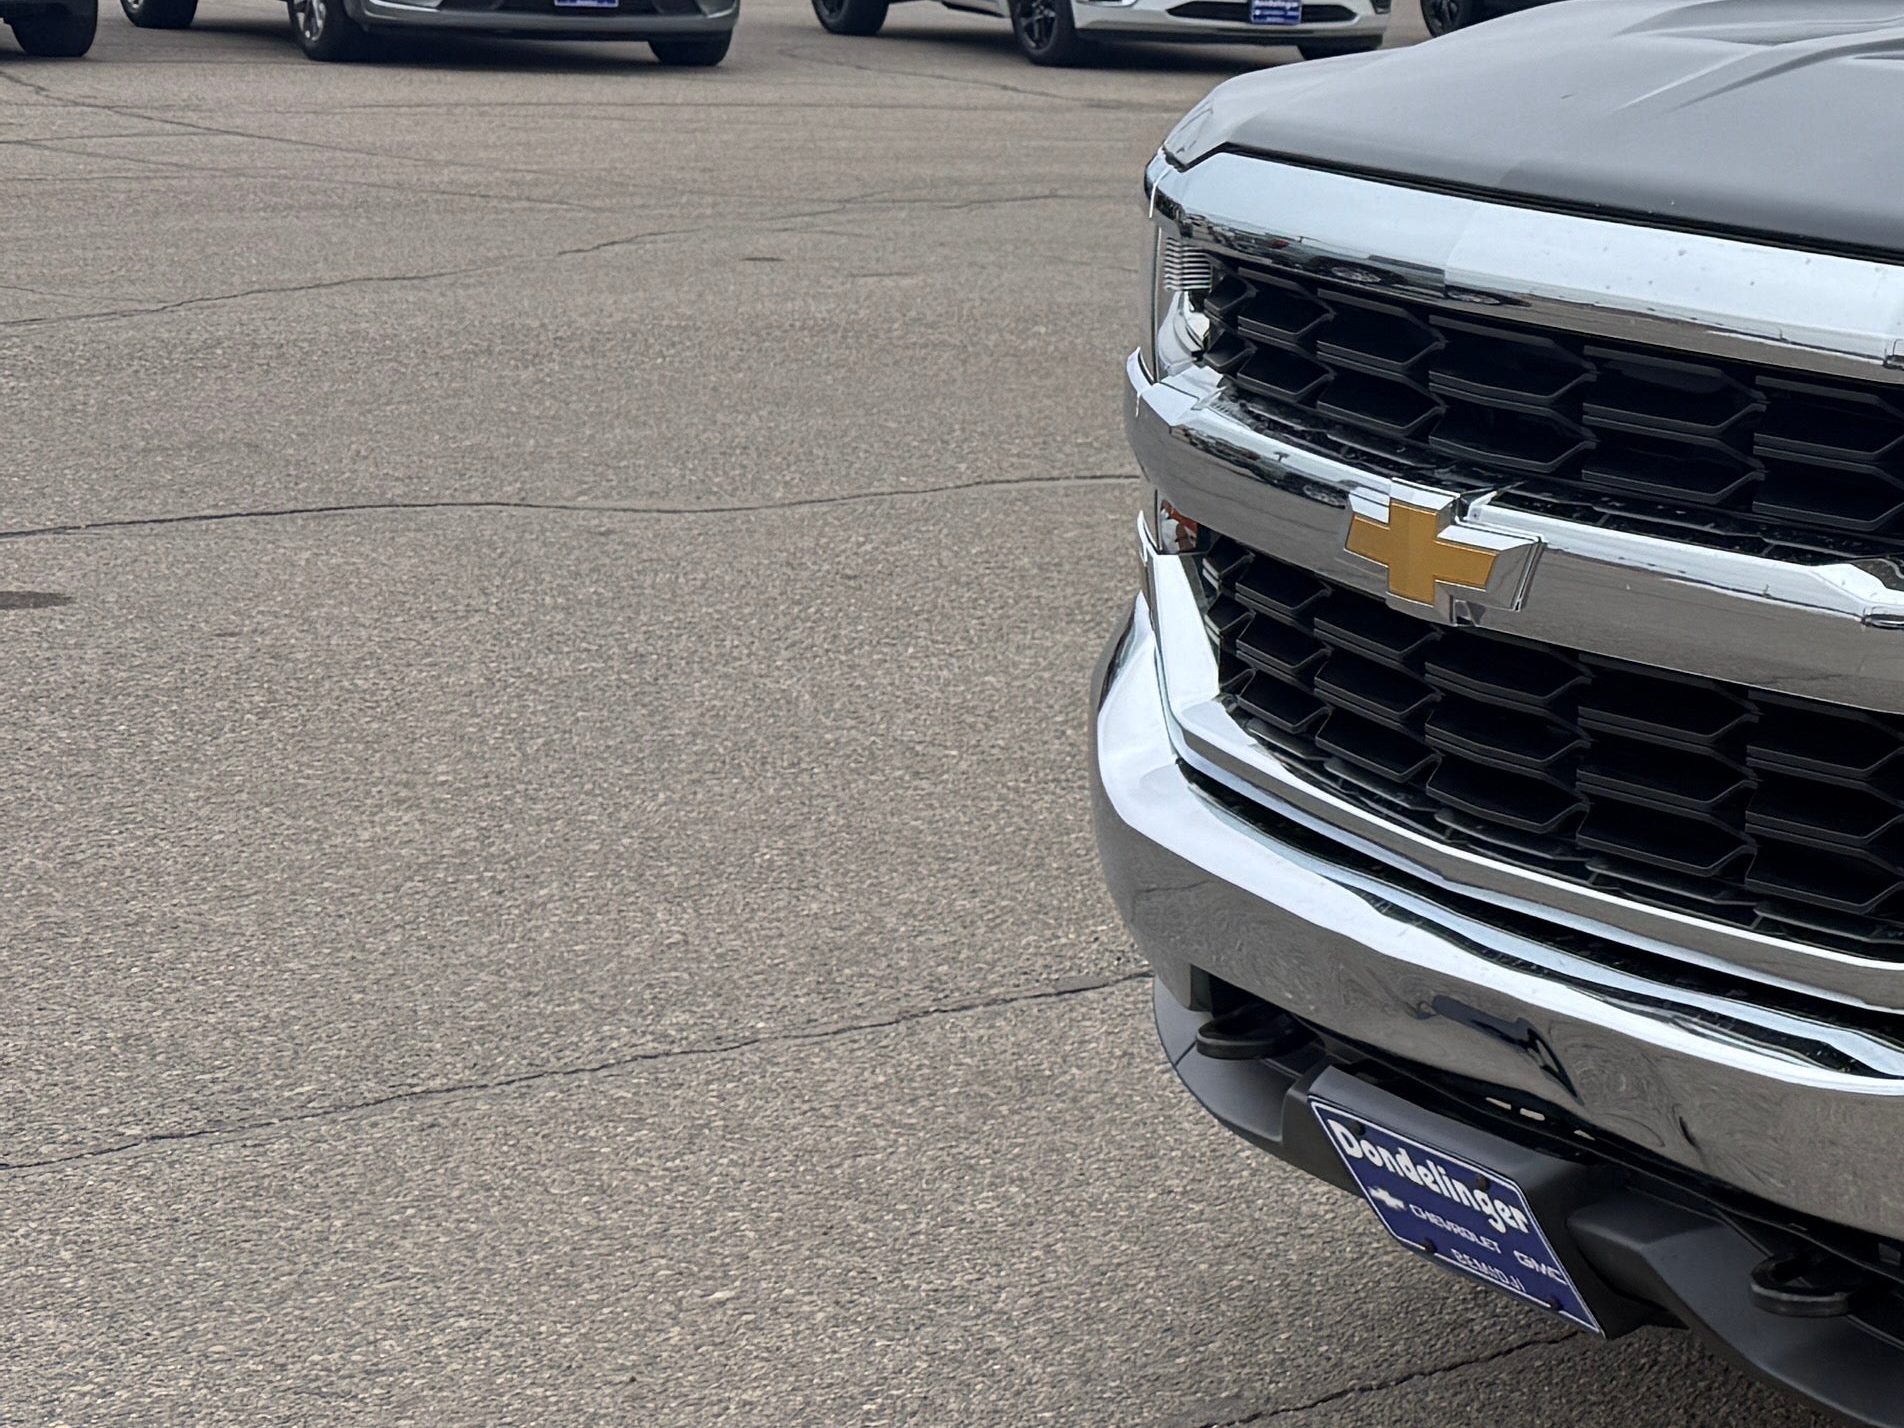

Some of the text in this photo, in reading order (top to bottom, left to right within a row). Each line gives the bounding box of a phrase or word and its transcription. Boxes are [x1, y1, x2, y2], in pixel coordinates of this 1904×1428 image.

[1327, 1118, 1529, 1234] Dondelinger
[1409, 1203, 1568, 1285] CHEVROLET GMC
